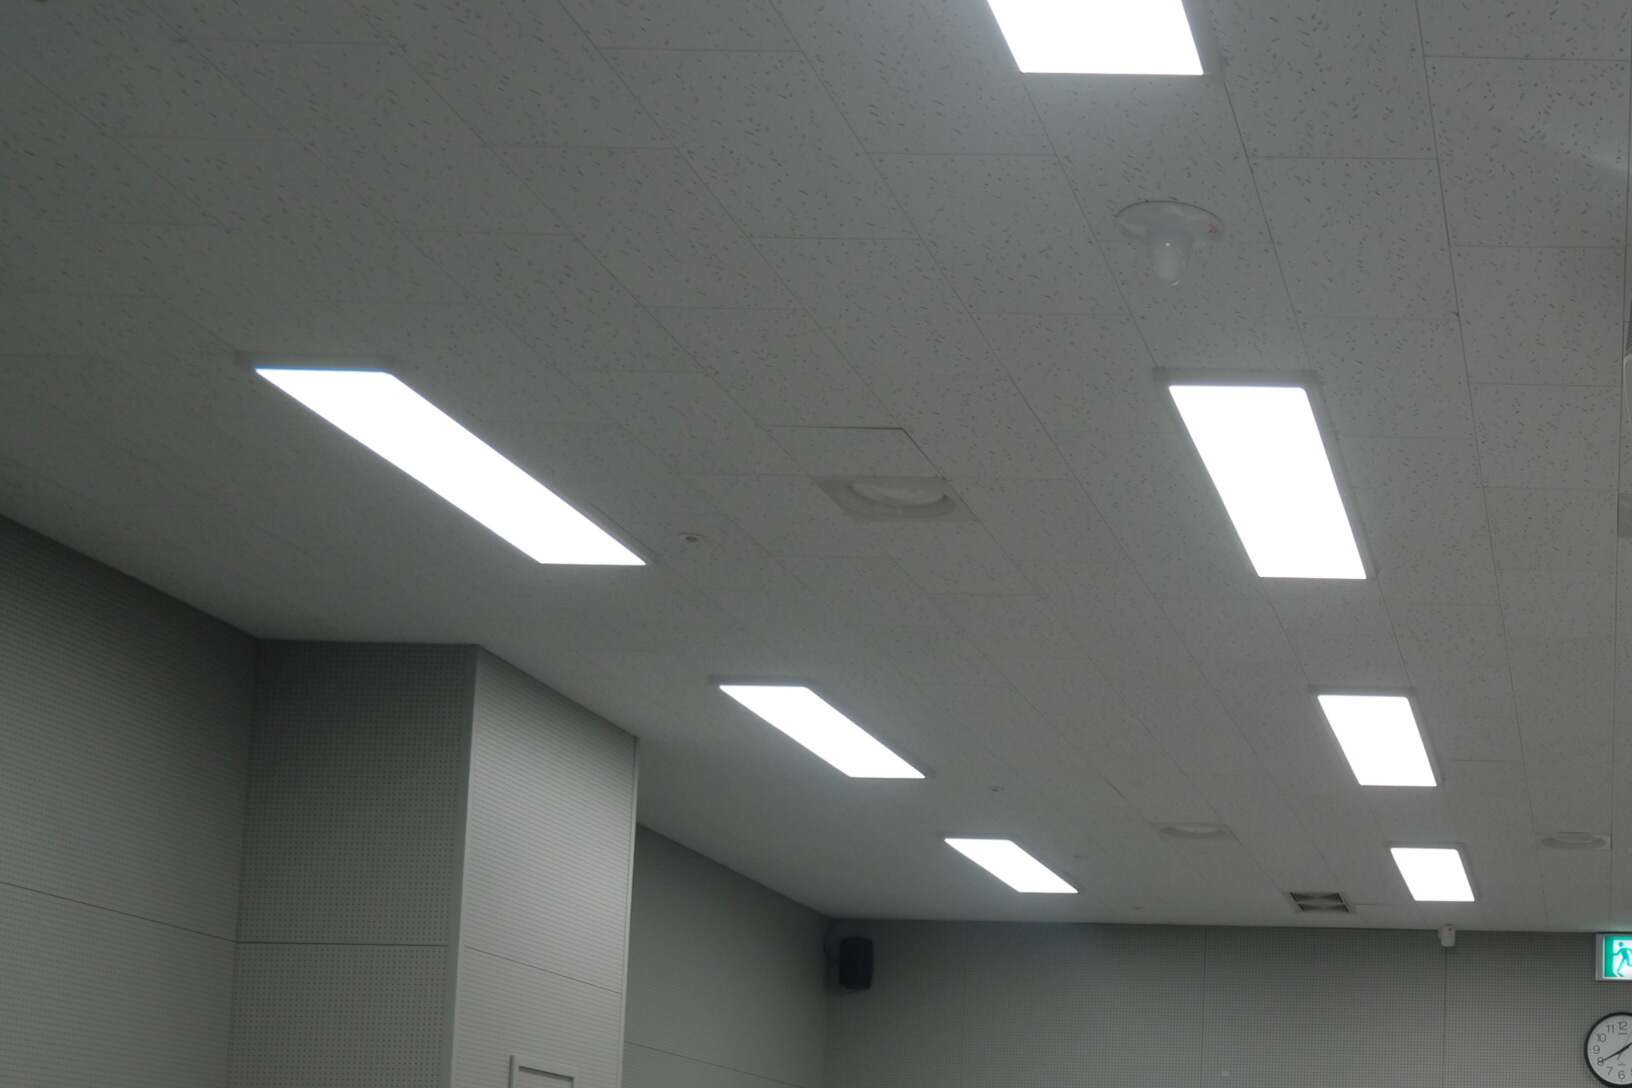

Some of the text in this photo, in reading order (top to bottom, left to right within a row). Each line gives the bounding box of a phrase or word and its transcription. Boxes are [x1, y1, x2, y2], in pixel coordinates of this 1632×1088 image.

[1607, 1024, 1614, 1033] 11
[1618, 1021, 1628, 1030] 12
[1597, 1033, 1606, 1042] 10
[1592, 1045, 1600, 1054] 9
[1597, 1056, 1604, 1066] 8
[1606, 1066, 1613, 1076] 7
[1618, 1070, 1625, 1080] 6
